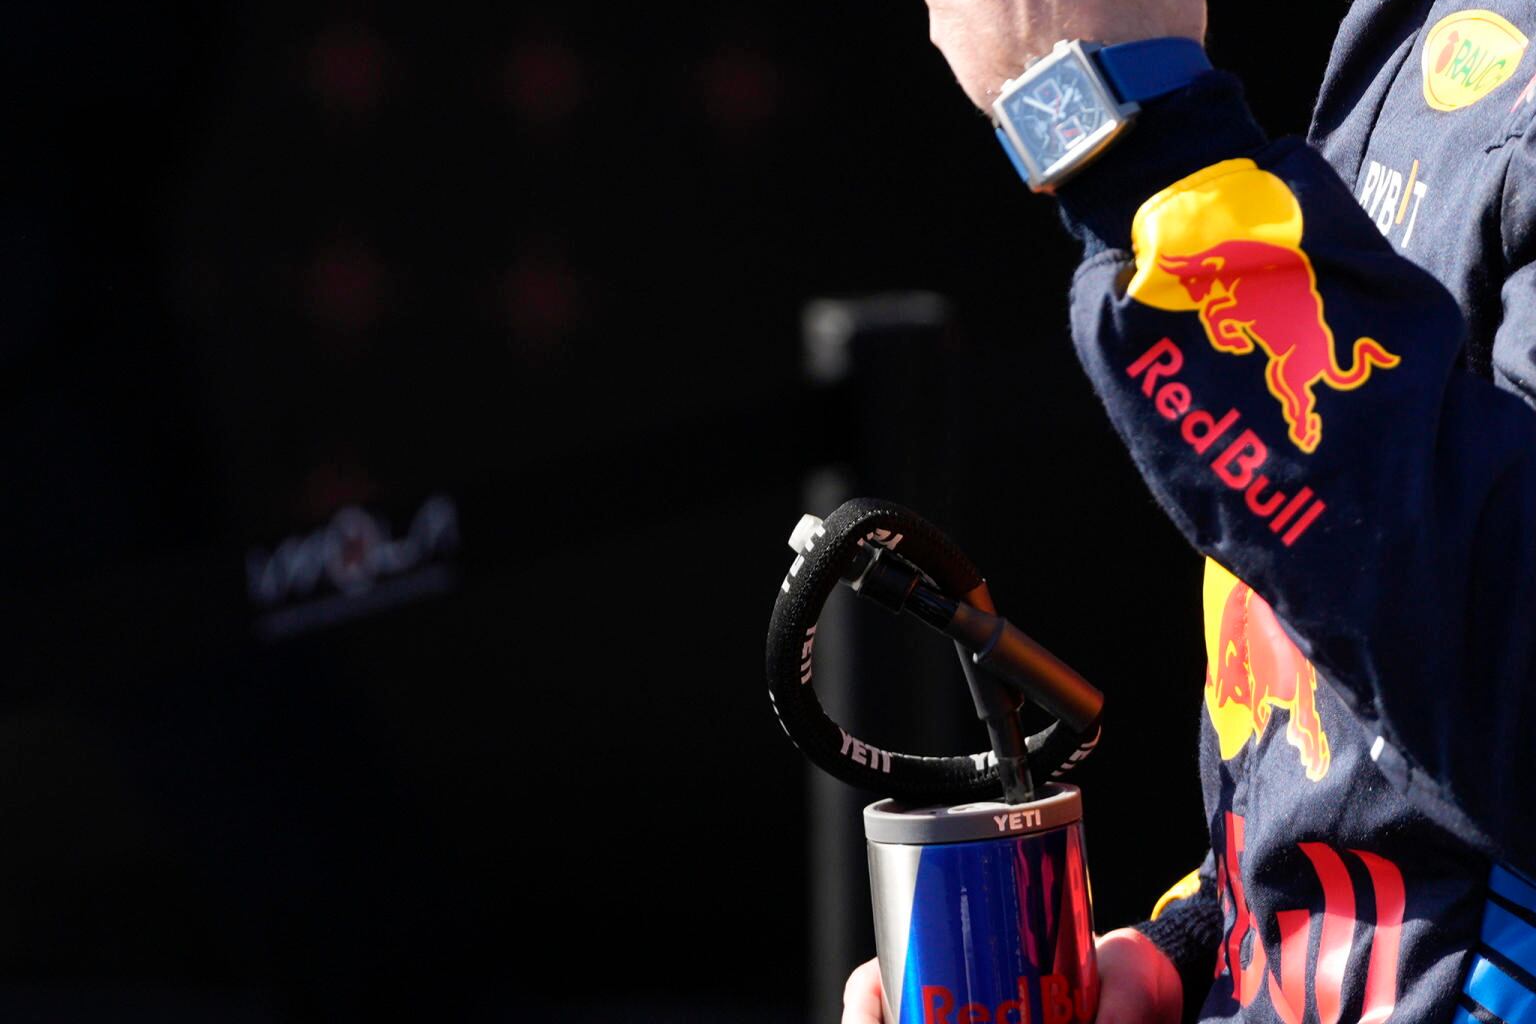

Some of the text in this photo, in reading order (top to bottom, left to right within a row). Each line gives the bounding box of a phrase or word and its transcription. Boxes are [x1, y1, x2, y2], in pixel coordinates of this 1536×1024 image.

[838, 726, 894, 774] YETI
[993, 809, 1042, 832] YETI
[1039, 974, 1098, 1024] Bu
